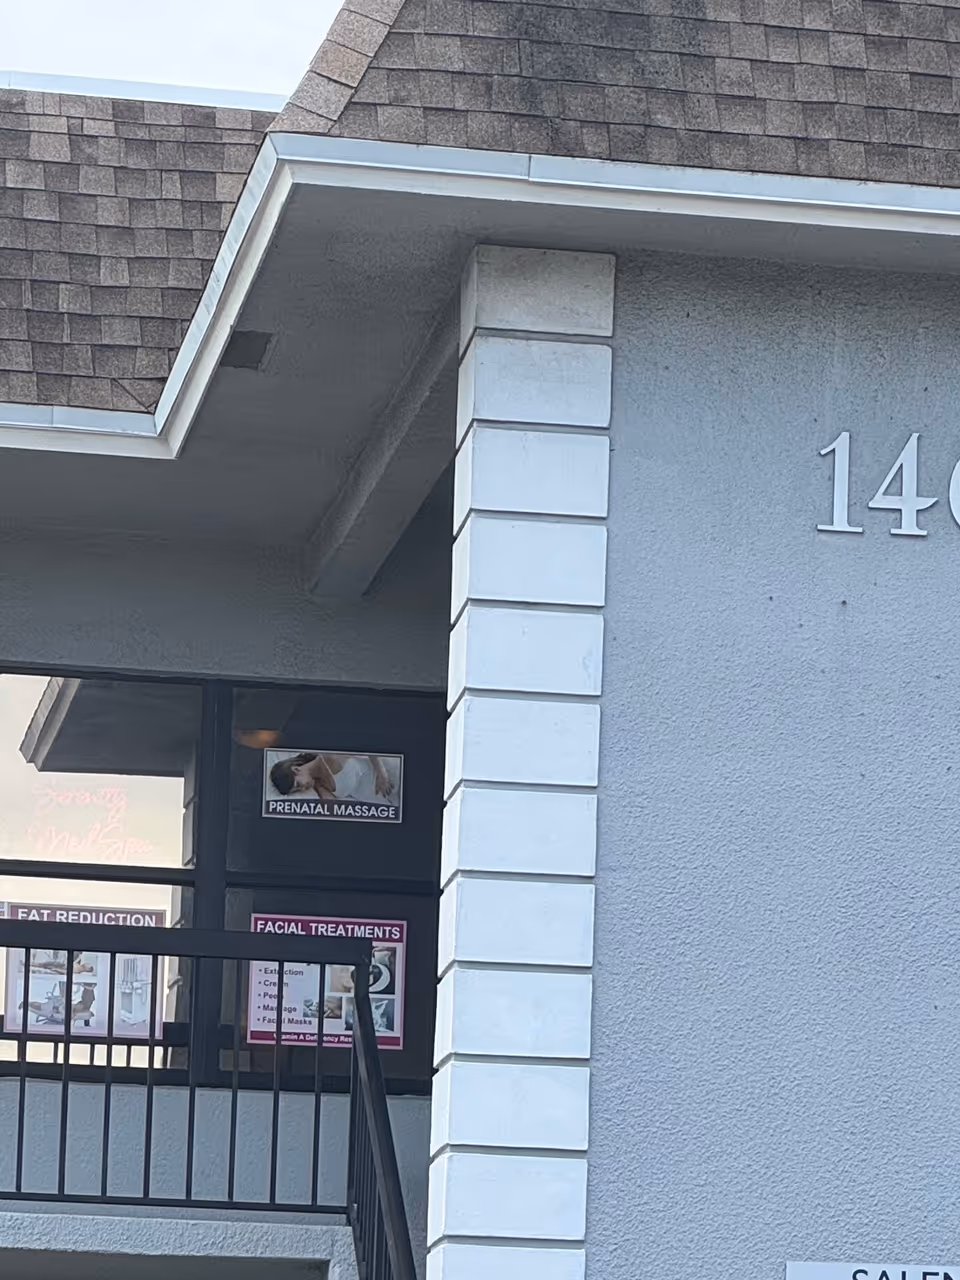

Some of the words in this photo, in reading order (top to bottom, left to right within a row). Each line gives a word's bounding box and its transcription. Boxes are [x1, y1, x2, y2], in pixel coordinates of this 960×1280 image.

[269, 801, 330, 815] PRENATAL
[333, 804, 396, 818] MASSAGE
[17, 908, 51, 921] FAT
[56, 910, 156, 926] REDUCTION
[257, 920, 306, 935] FACIAL
[310, 923, 401, 939] TREATMENTS
[264, 967, 304, 976] Extction
[263, 979, 289, 987] Crem
